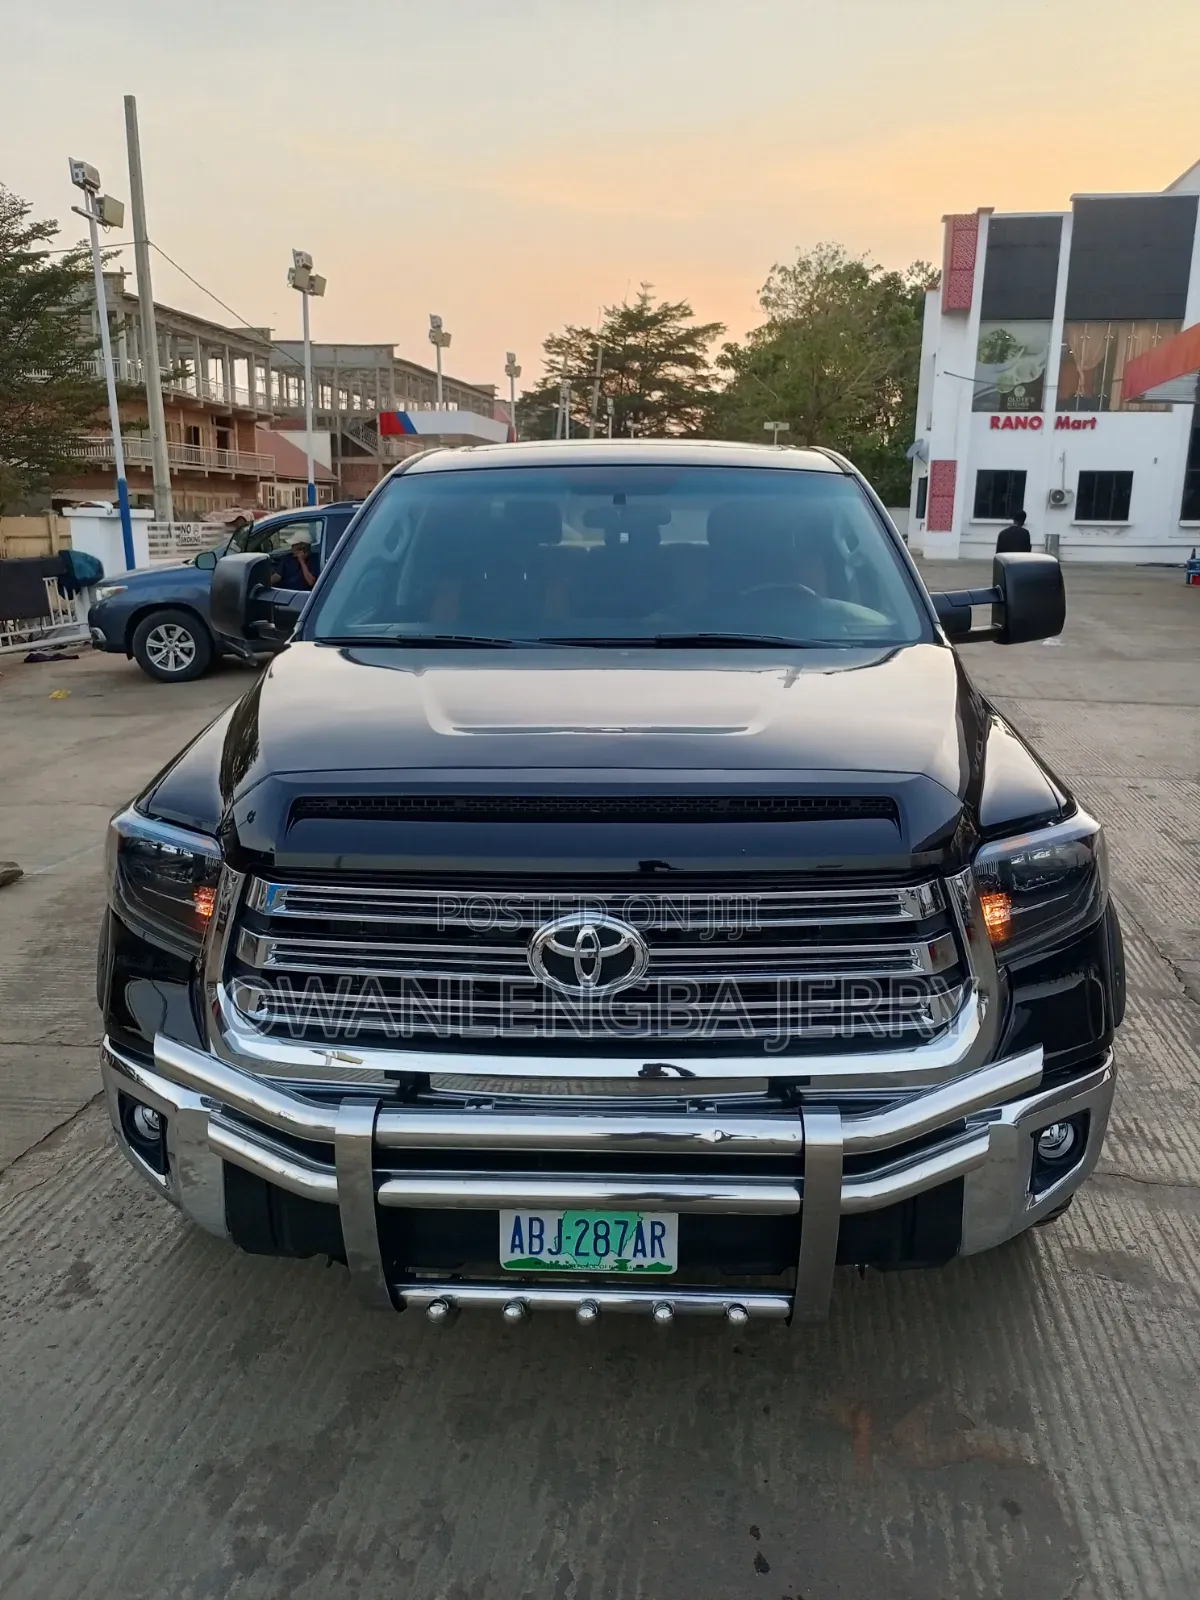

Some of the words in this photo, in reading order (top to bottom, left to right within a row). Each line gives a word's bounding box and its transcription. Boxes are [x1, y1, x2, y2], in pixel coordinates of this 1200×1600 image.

[990, 416, 1042, 430] RANO
[1054, 416, 1097, 430] Mart
[181, 524, 191, 534] NO
